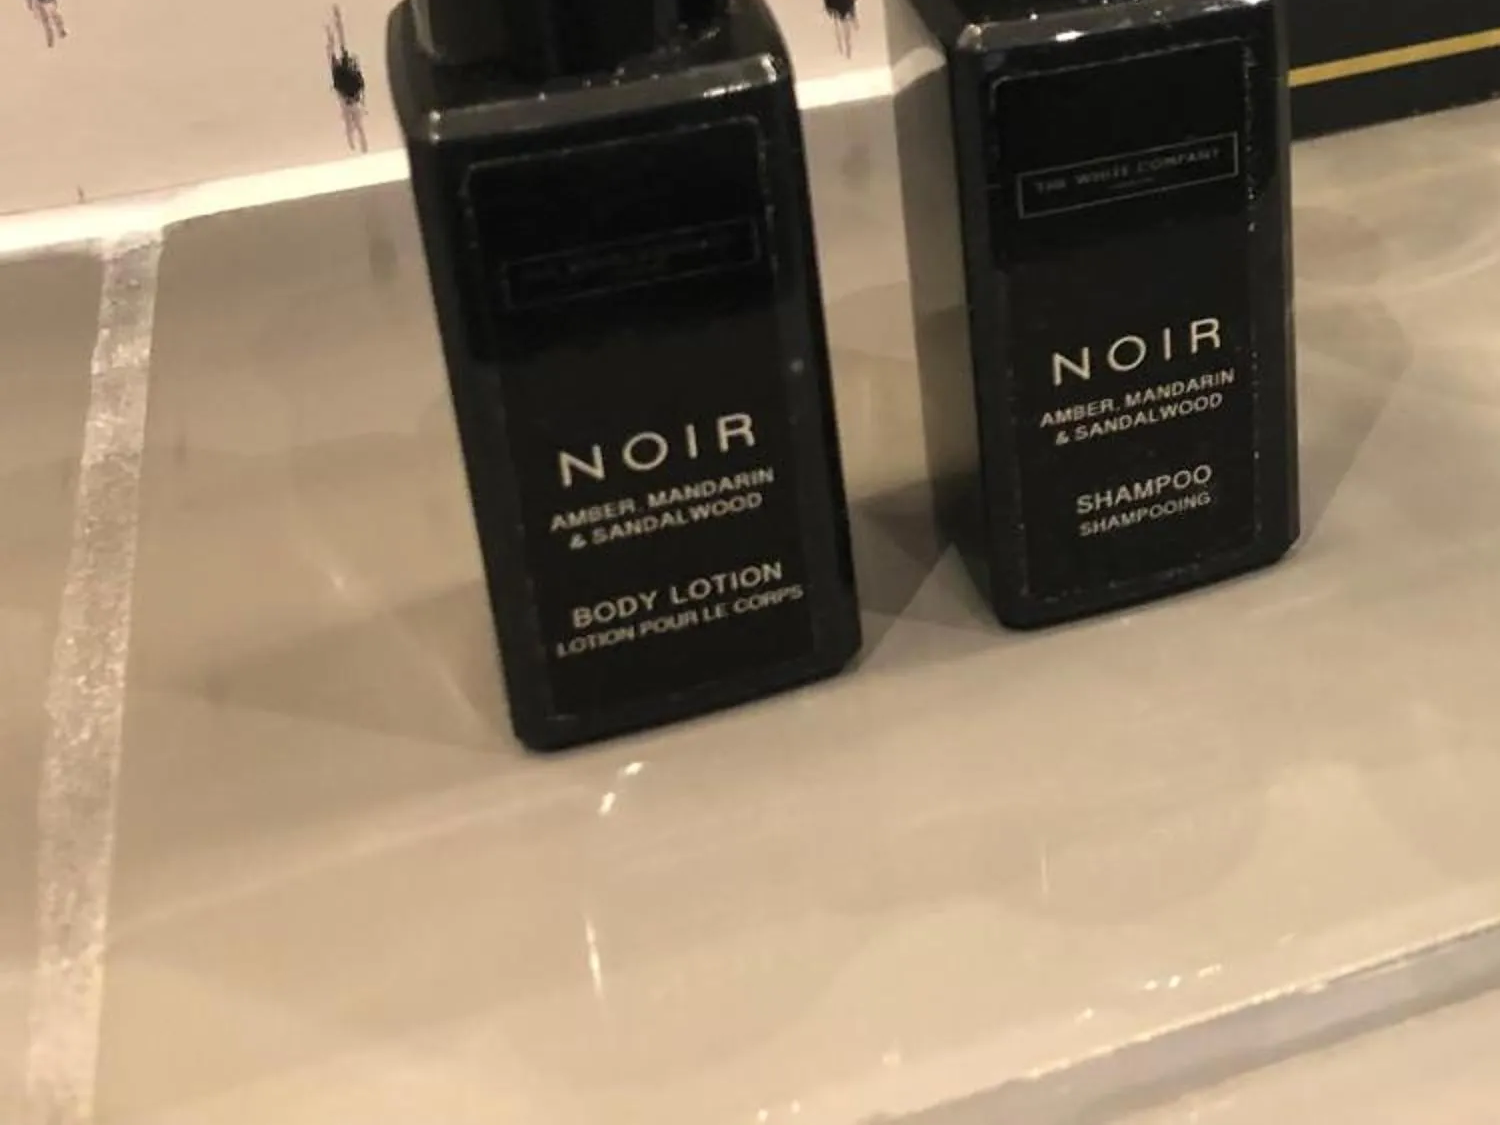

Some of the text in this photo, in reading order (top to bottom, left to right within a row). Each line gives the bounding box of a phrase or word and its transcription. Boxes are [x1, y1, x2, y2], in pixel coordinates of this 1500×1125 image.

[1051, 316, 1222, 387] NOIR
[1124, 368, 1235, 409] MANDARIN
[1054, 392, 1224, 446] & SANDALWOOD
[557, 411, 756, 489] NOIR
[647, 466, 775, 509] MANDARIN
[1075, 463, 1213, 515] SHAMPOO
[1078, 490, 1212, 538] SHAMPOOING
[568, 491, 764, 550] & SANDALWOOD
[556, 583, 805, 659] LOTION POUR LE CORPS
[572, 561, 784, 629] BODY LOTION
